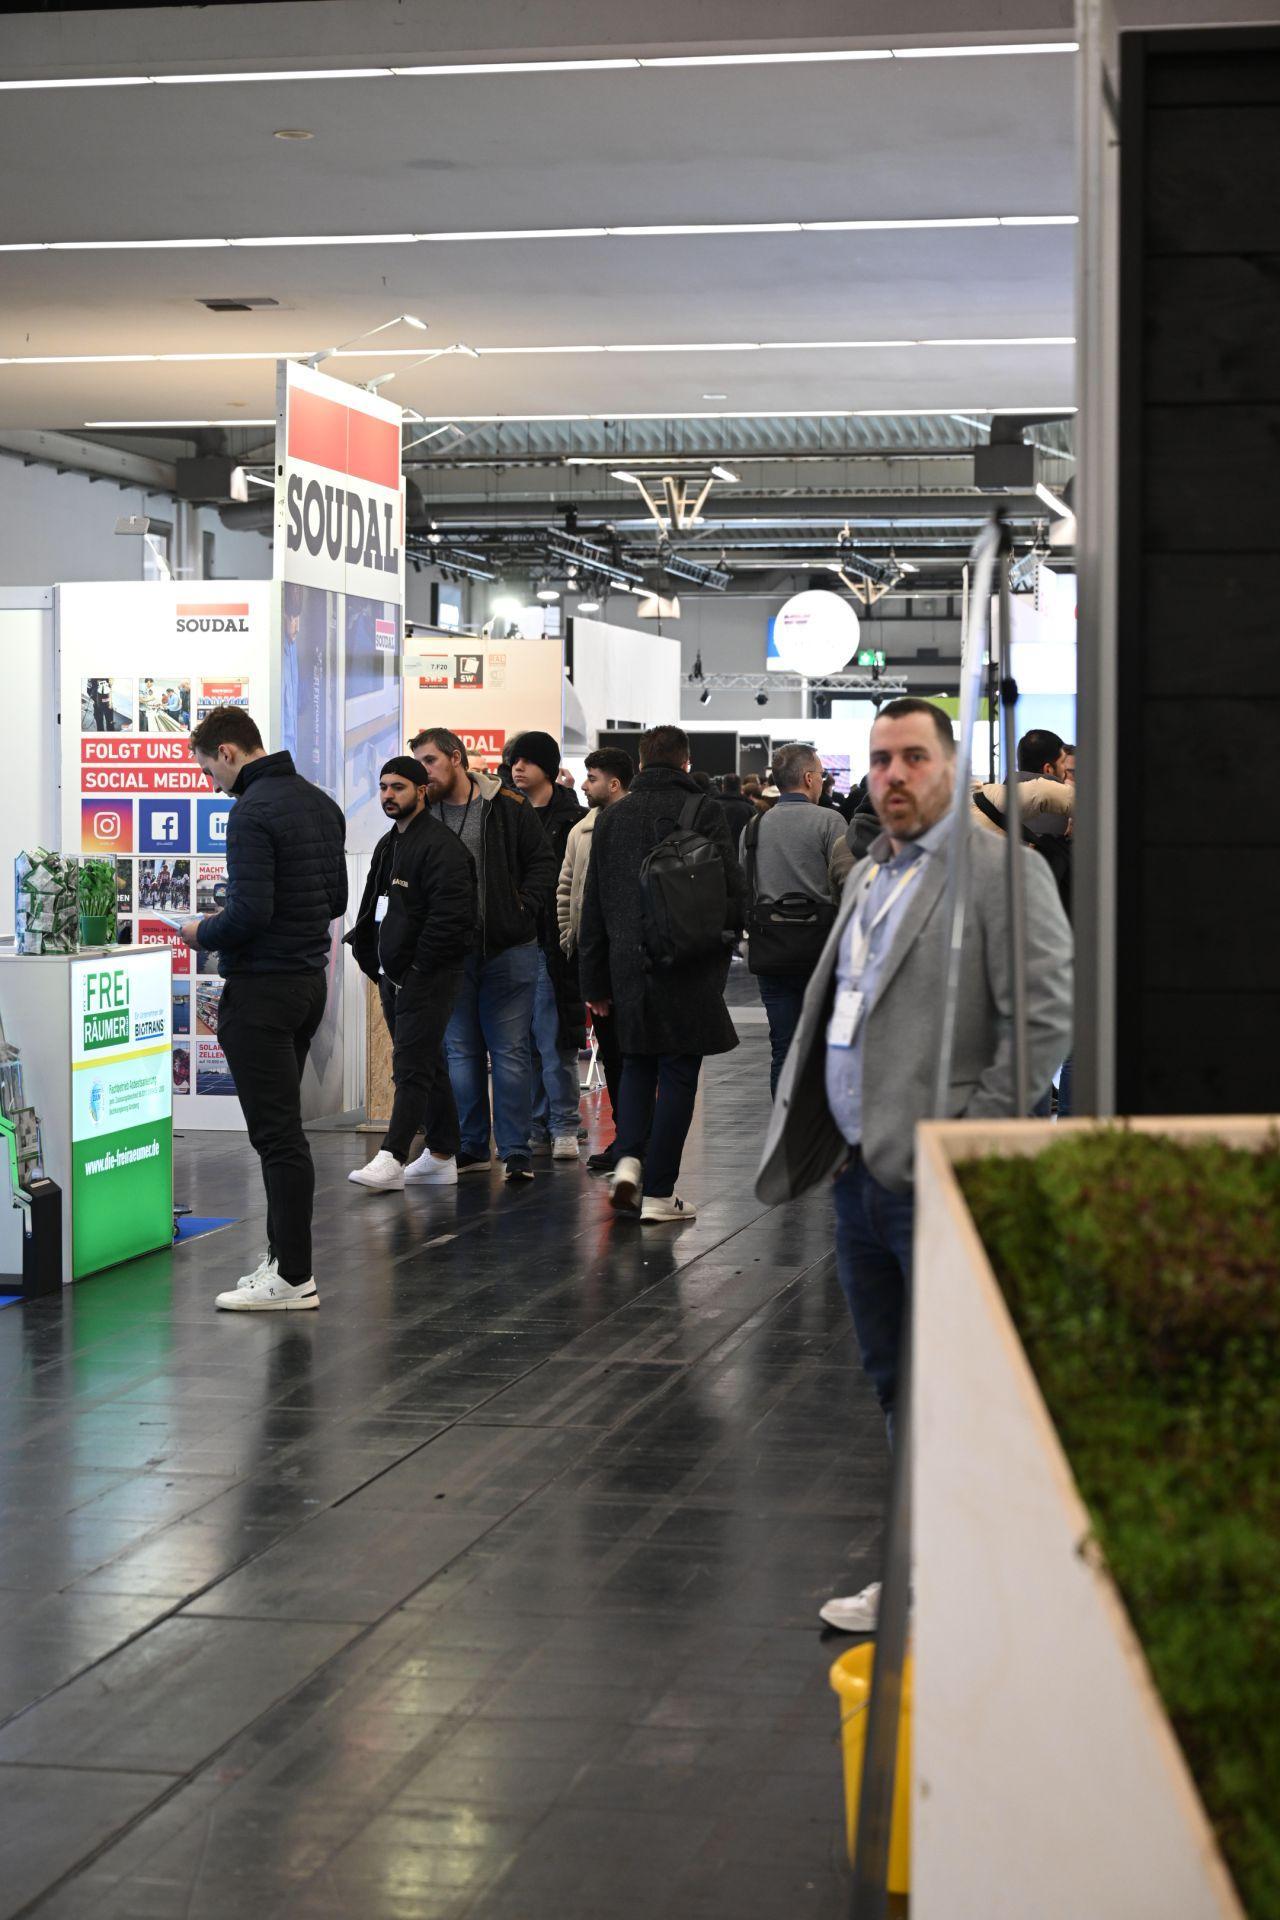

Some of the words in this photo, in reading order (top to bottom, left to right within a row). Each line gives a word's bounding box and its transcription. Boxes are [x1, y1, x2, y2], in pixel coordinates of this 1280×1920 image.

[287, 473, 399, 575] SOUDAL
[176, 618, 249, 633] SOUDAL
[376, 633, 395, 650] SOUDAL
[85, 743, 142, 759] FOLGT
[147, 743, 183, 759] UNS
[85, 772, 149, 788] SOCIAL
[154, 772, 209, 788] MEDIA
[116, 894, 130, 902] REN
[141, 935, 165, 945] POS
[167, 935, 184, 945] MI
[171, 948, 187, 958] EM
[84, 1016, 126, 1043] RÄUMER
[84, 1138, 160, 1176] www.die-freiraeumer.de
